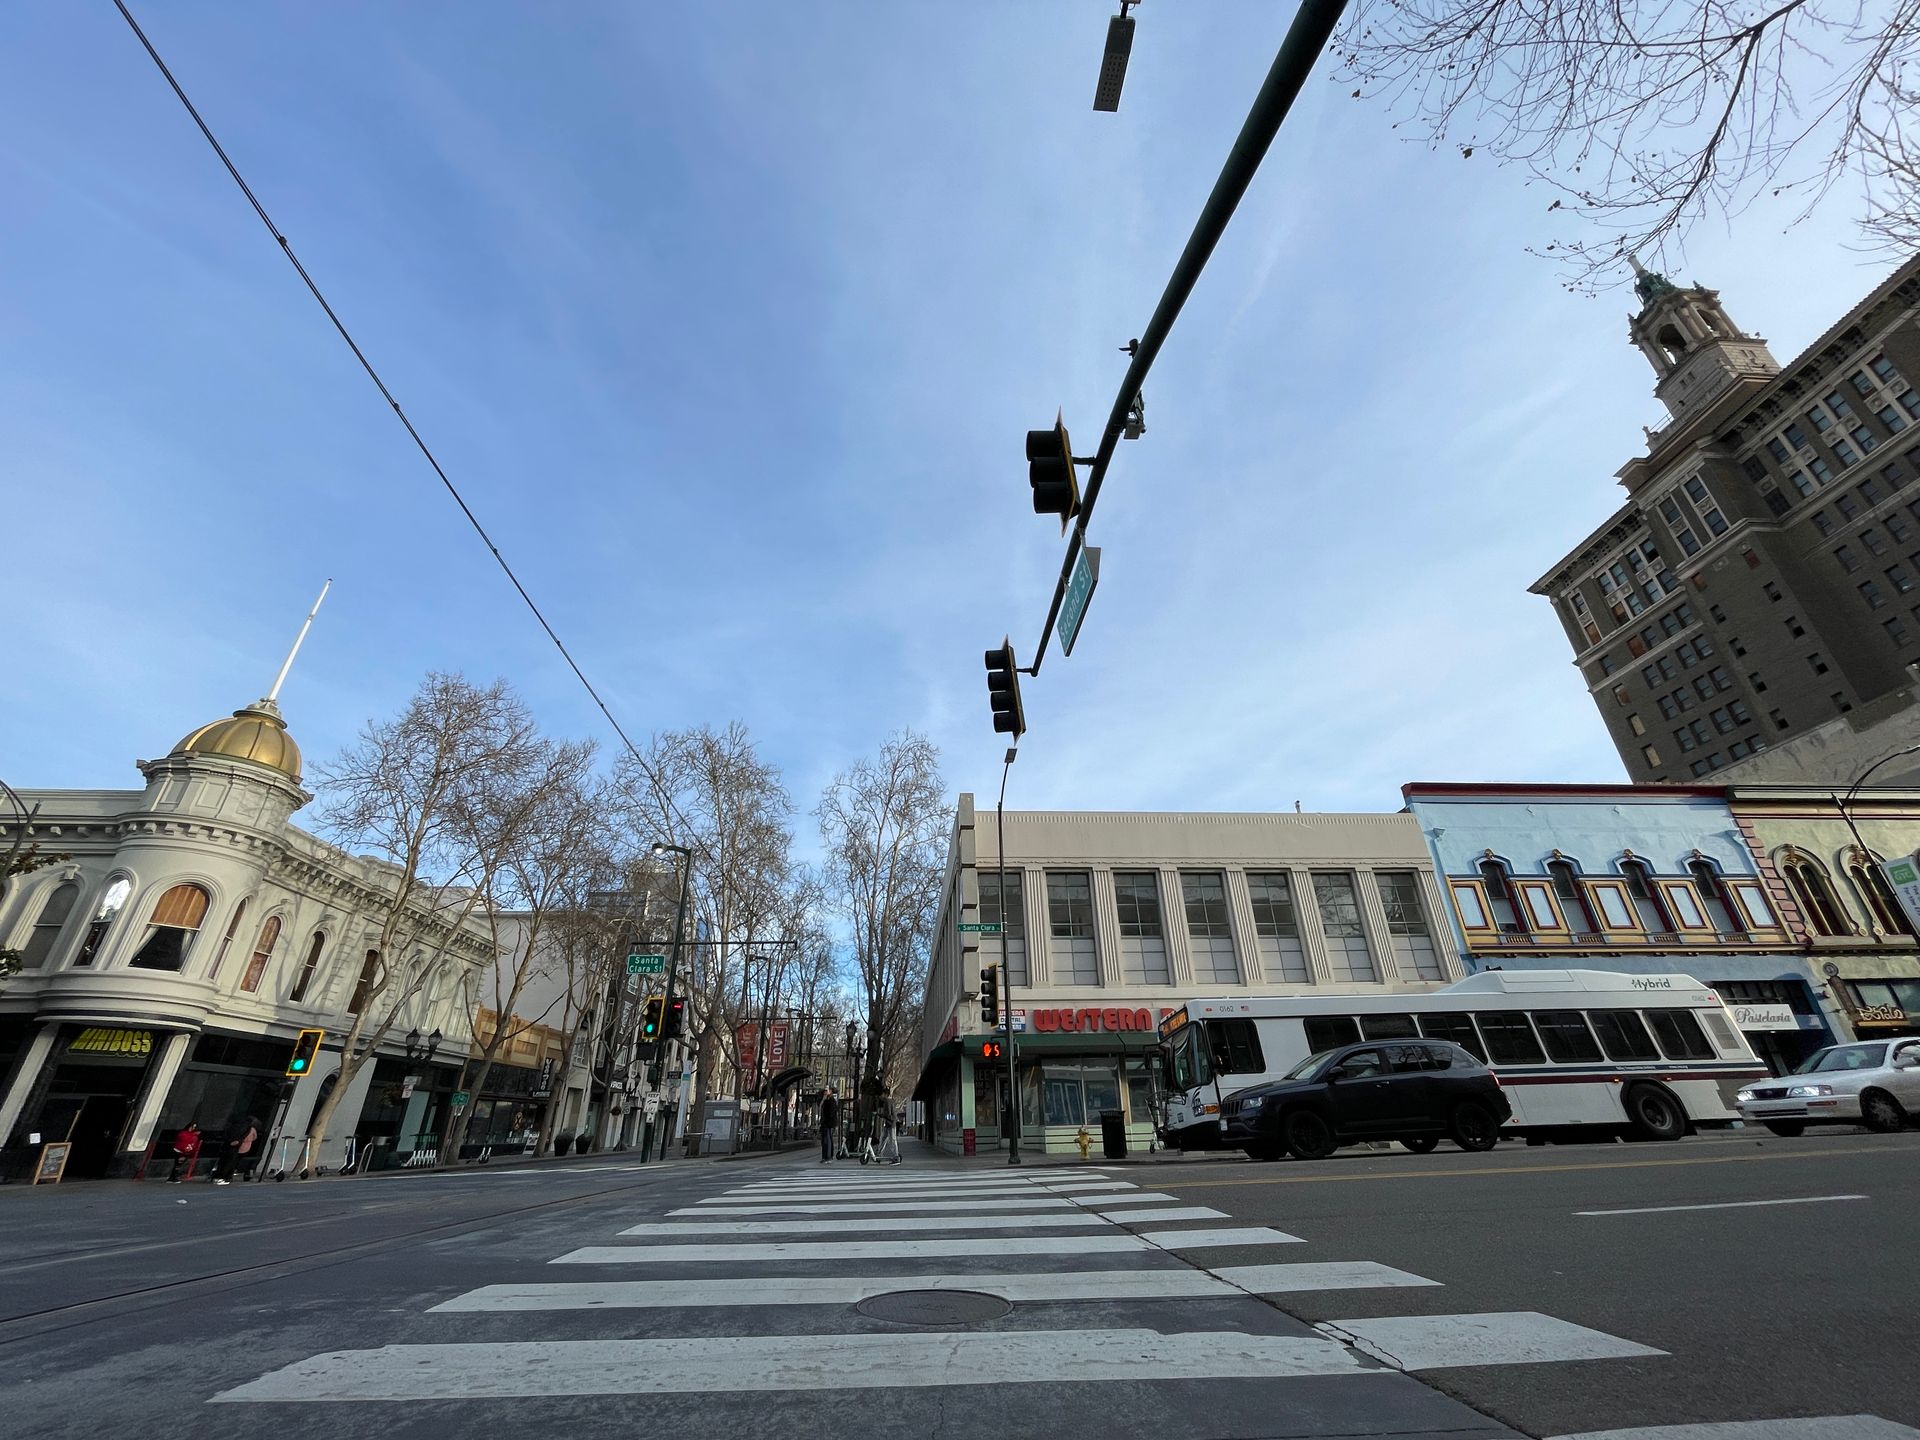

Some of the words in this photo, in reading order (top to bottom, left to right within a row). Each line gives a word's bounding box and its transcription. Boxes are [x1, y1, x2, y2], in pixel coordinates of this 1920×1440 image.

[1060, 586, 1080, 641] Second
[1079, 564, 1089, 589] St
[629, 965, 651, 973] Clara
[653, 965, 662, 973] St
[634, 956, 659, 964] Santa
[1631, 977, 1671, 991] Hybrid
[1034, 1008, 1152, 1032] WESTERN
[1735, 1007, 1791, 1023] Pastelaria
[71, 1028, 151, 1053] MINIBOSS
[772, 1030, 784, 1063] LOVE
